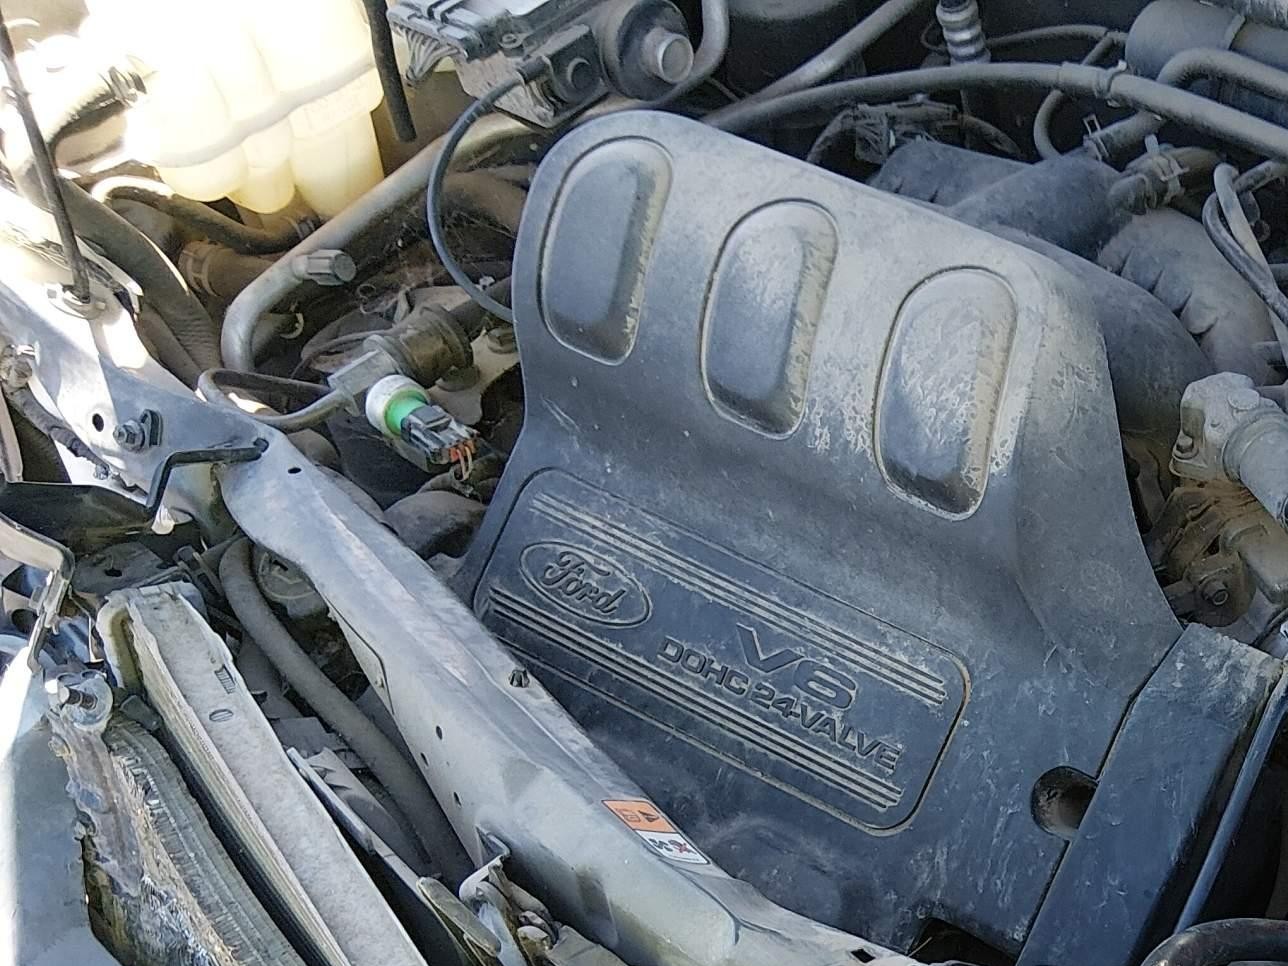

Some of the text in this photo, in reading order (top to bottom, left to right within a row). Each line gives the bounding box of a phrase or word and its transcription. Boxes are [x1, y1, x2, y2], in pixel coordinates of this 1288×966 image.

[543, 551, 626, 616] Ford
[657, 636, 749, 696] DOHC
[736, 623, 858, 713] V6
